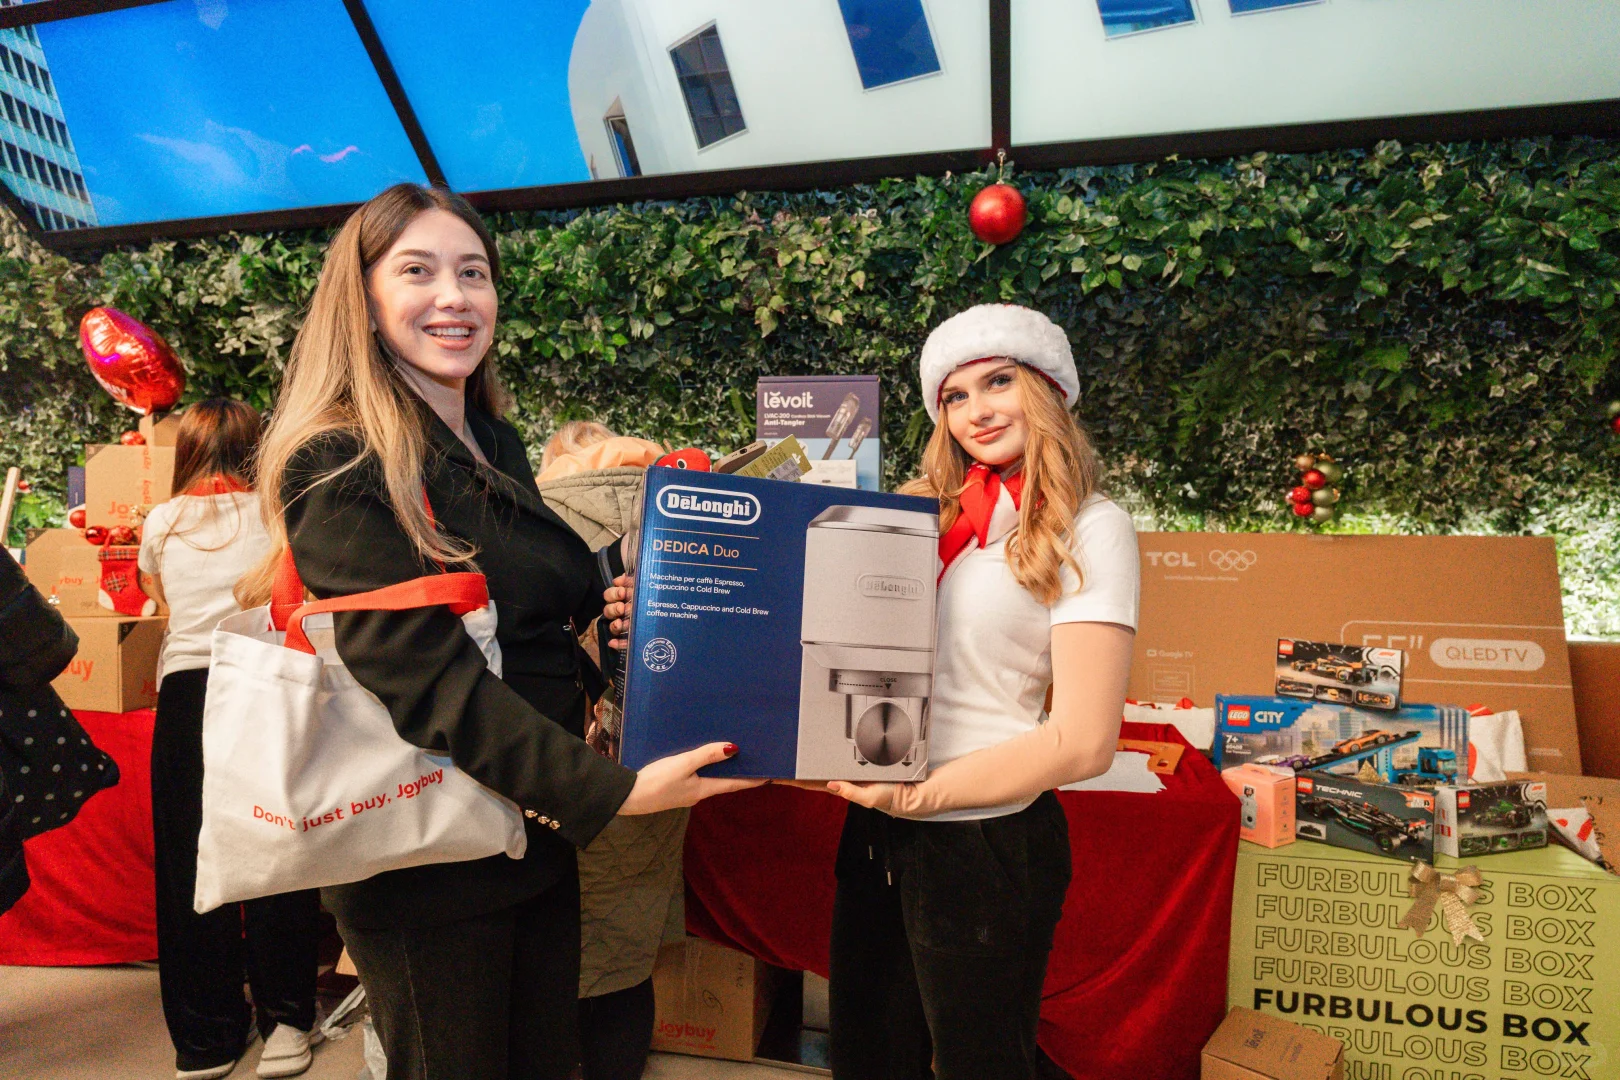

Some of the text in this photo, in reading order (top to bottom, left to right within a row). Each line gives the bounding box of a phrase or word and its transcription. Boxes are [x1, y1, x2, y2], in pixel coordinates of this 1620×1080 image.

[764, 419, 806, 427] Anti-Tangler
[652, 539, 740, 559] DEDICA Duo
[1146, 551, 1196, 568] TCL
[648, 582, 688, 592] Cappuccino
[650, 573, 682, 582] Macchina
[714, 578, 746, 588] Espresso,
[647, 600, 679, 609] Espresso,
[681, 602, 720, 612] Cappuccino
[736, 606, 750, 614] Cold
[752, 608, 770, 616] Brew
[670, 612, 698, 620] machine
[1445, 646, 1498, 662] QLED
[1501, 648, 1528, 662] TV
[1228, 710, 1249, 719] LEGO
[1254, 710, 1284, 724] CITY
[1226, 734, 1239, 744] 7+
[1315, 784, 1364, 798] TECHNIC
[253, 768, 444, 832] Don't just buy, Joybuy
[1257, 862, 1596, 914] FURBULS BOX
[1506, 914, 1596, 947] BOX
[1255, 925, 1594, 980] FURBULOUS BOX
[1254, 956, 1593, 1014] FURBULOUS BOX
[1254, 988, 1590, 1046] FURBULOUS BOX
[657, 1018, 716, 1042] Joybuy
[1500, 1044, 1591, 1080] BOX
